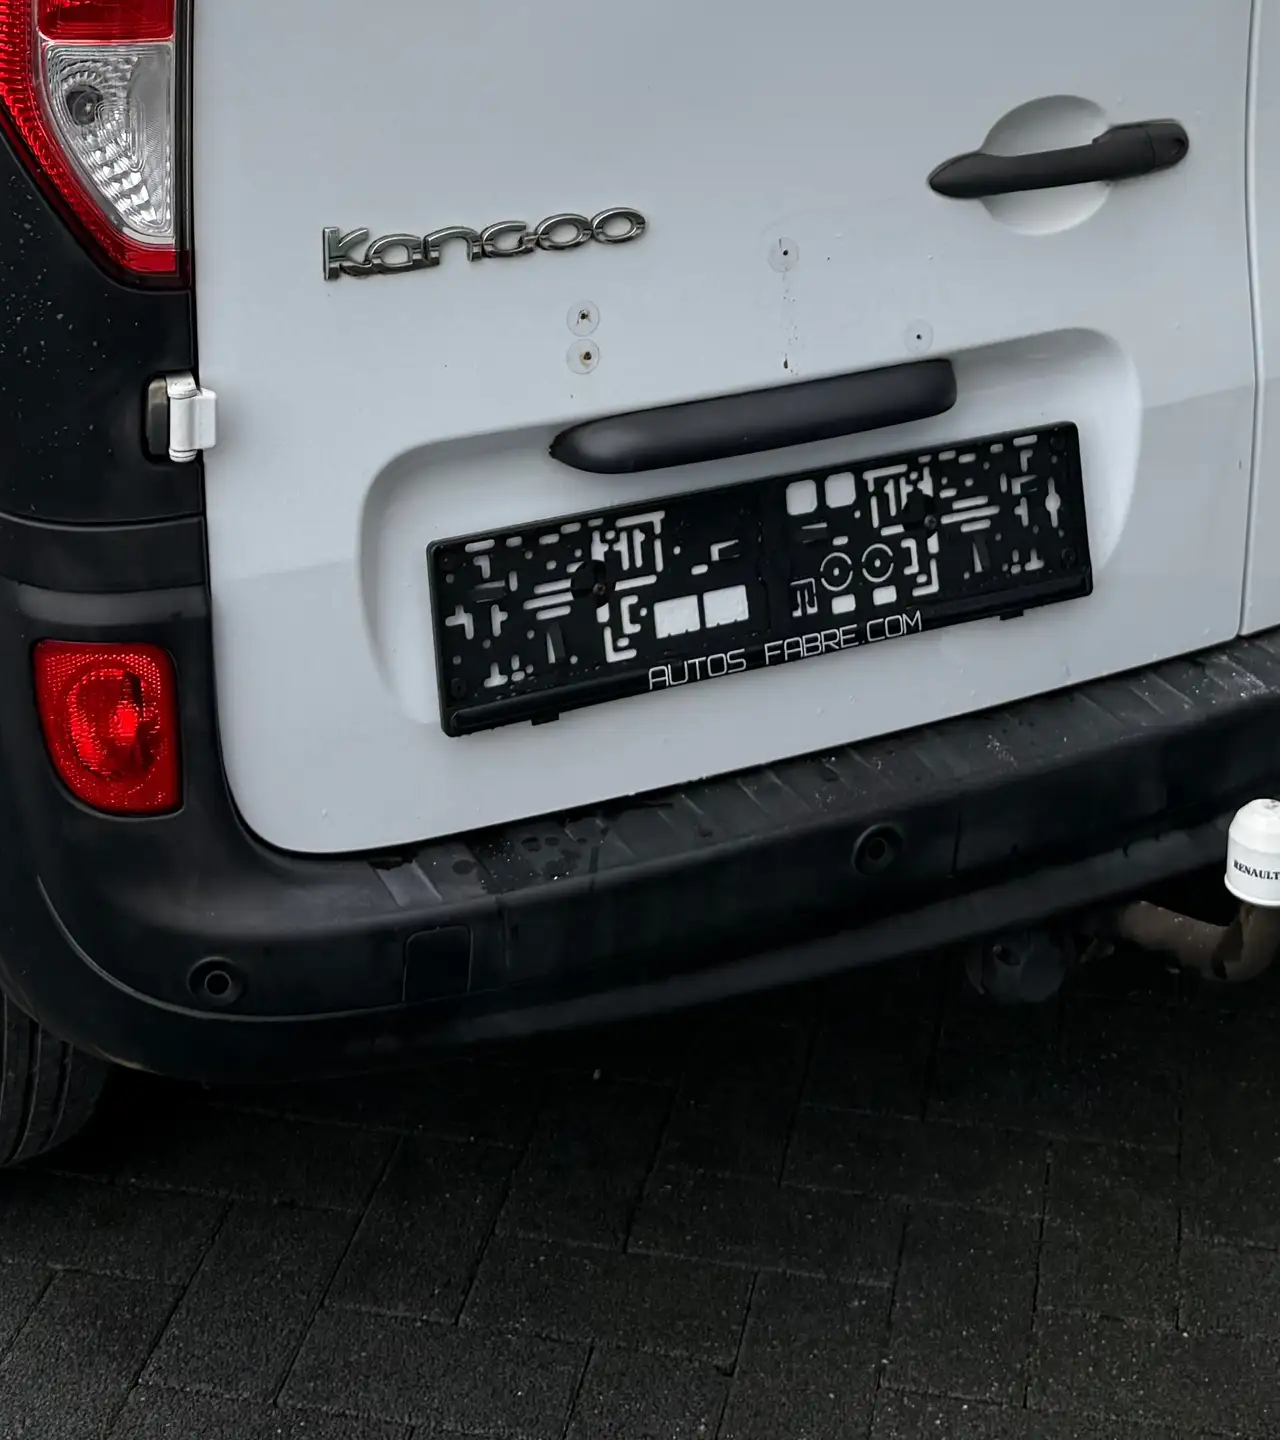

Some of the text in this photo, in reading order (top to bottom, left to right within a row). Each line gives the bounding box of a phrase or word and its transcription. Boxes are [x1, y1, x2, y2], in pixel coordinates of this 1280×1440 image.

[322, 206, 647, 282] Kangoo
[648, 648, 747, 690] AUTOS
[1233, 859, 1280, 881] RENAULT
